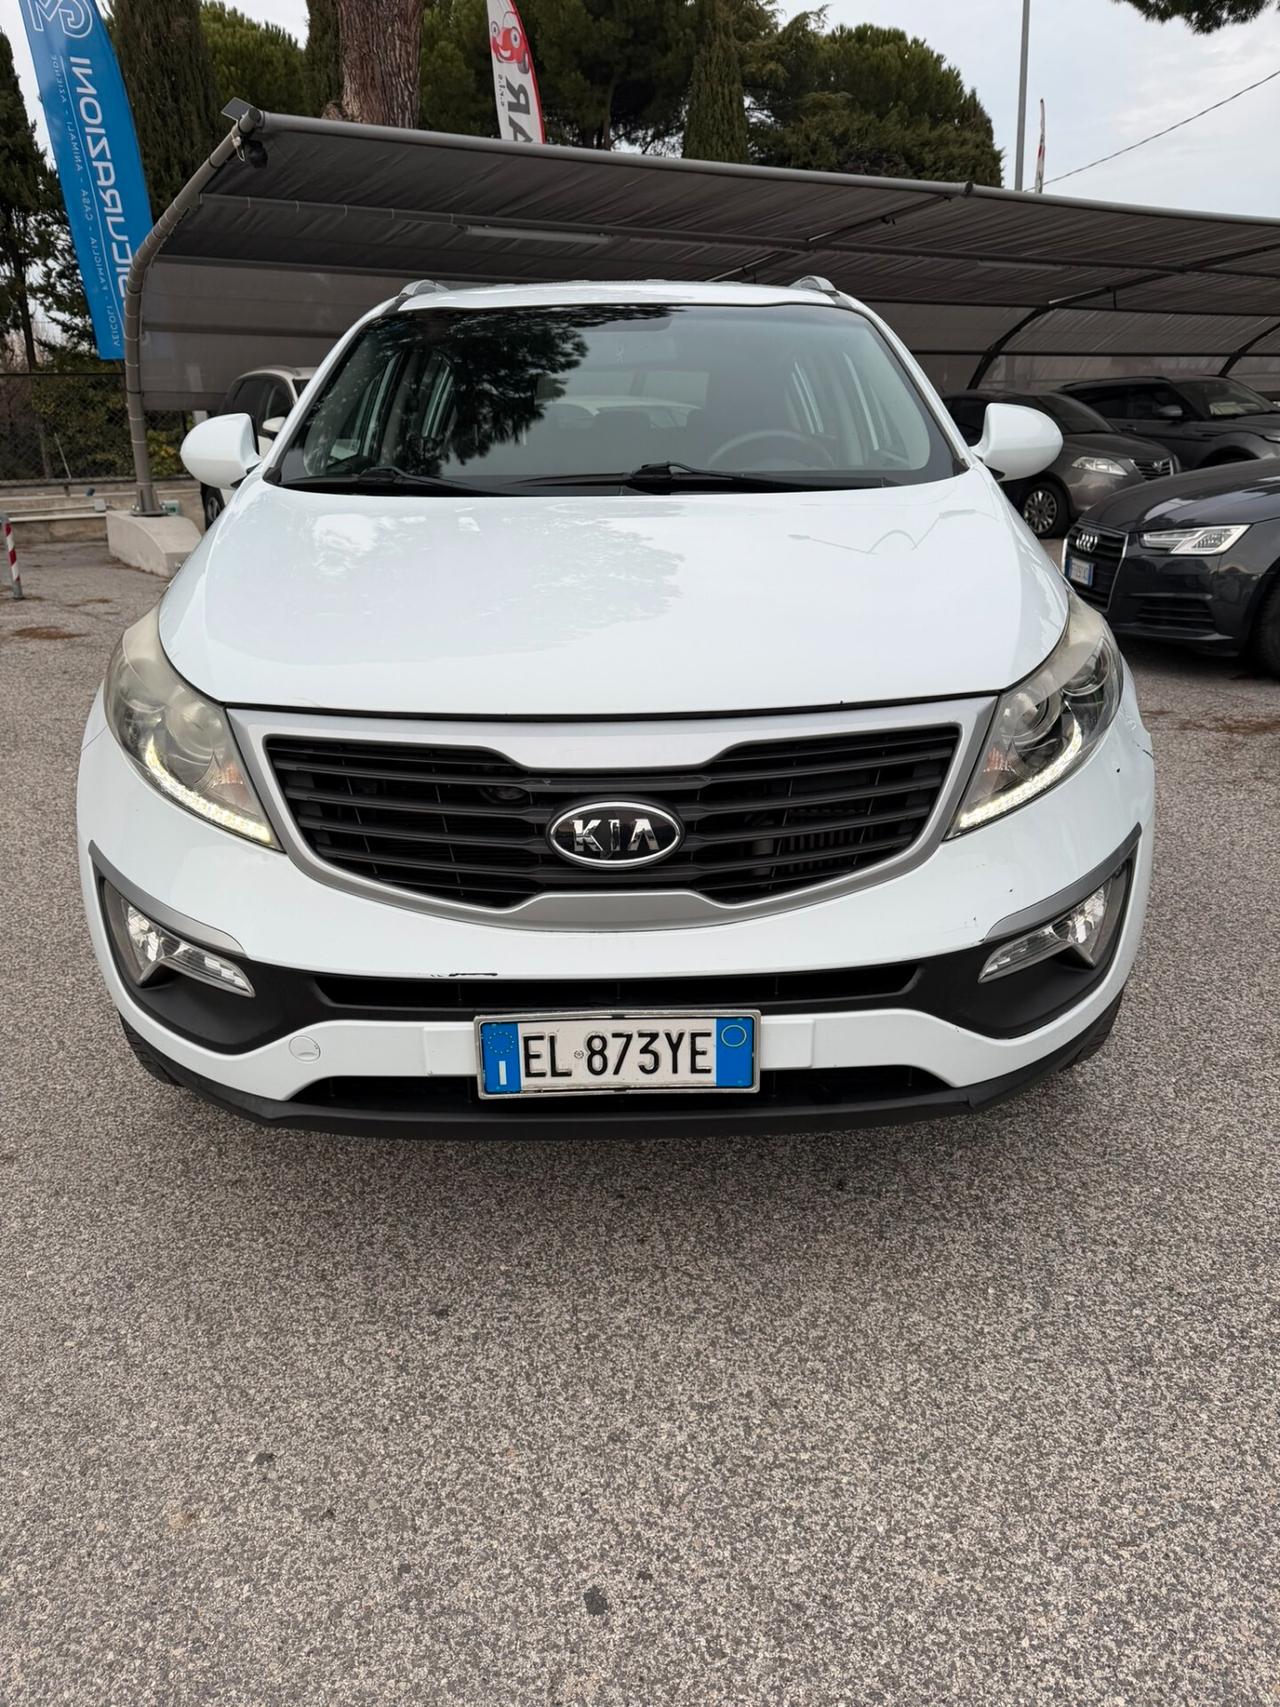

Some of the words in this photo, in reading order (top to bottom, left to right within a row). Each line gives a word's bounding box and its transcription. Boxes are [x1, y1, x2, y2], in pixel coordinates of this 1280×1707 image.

[572, 818, 660, 852] KIA
[523, 1034, 572, 1078] EL
[586, 1031, 712, 1076] 873YE
